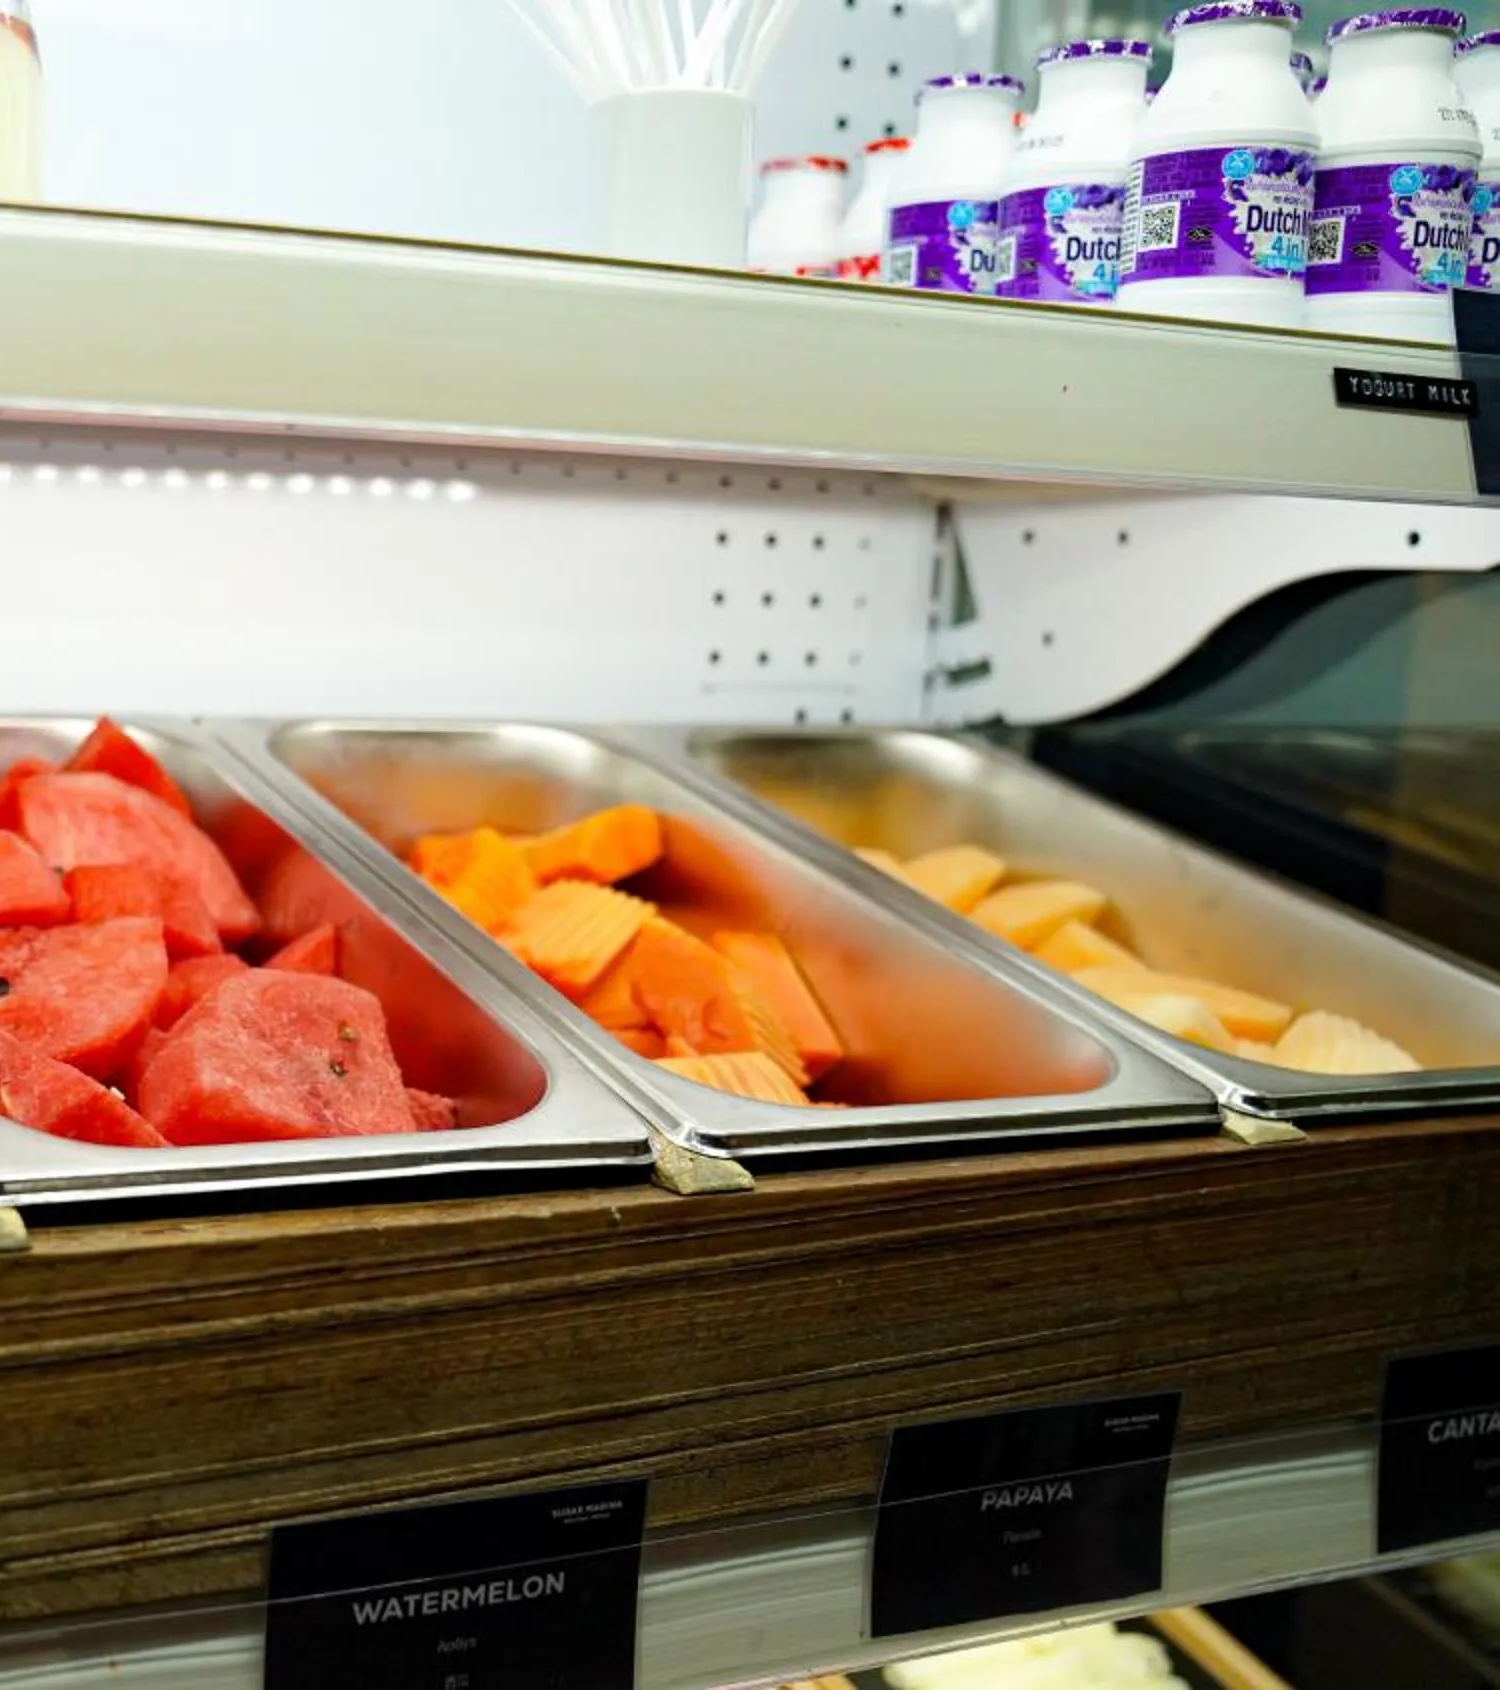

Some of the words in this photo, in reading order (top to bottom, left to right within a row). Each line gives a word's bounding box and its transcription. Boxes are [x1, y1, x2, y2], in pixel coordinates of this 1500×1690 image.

[1246, 204, 1301, 235] Dutch
[1271, 236, 1284, 254] 4
[1349, 376, 1416, 400] YOGURT
[1428, 384, 1472, 406] MILK
[1427, 1411, 1500, 1445] CANTA
[980, 1481, 1074, 1512] PAPAYA
[351, 1571, 566, 1626] WATERMELON
